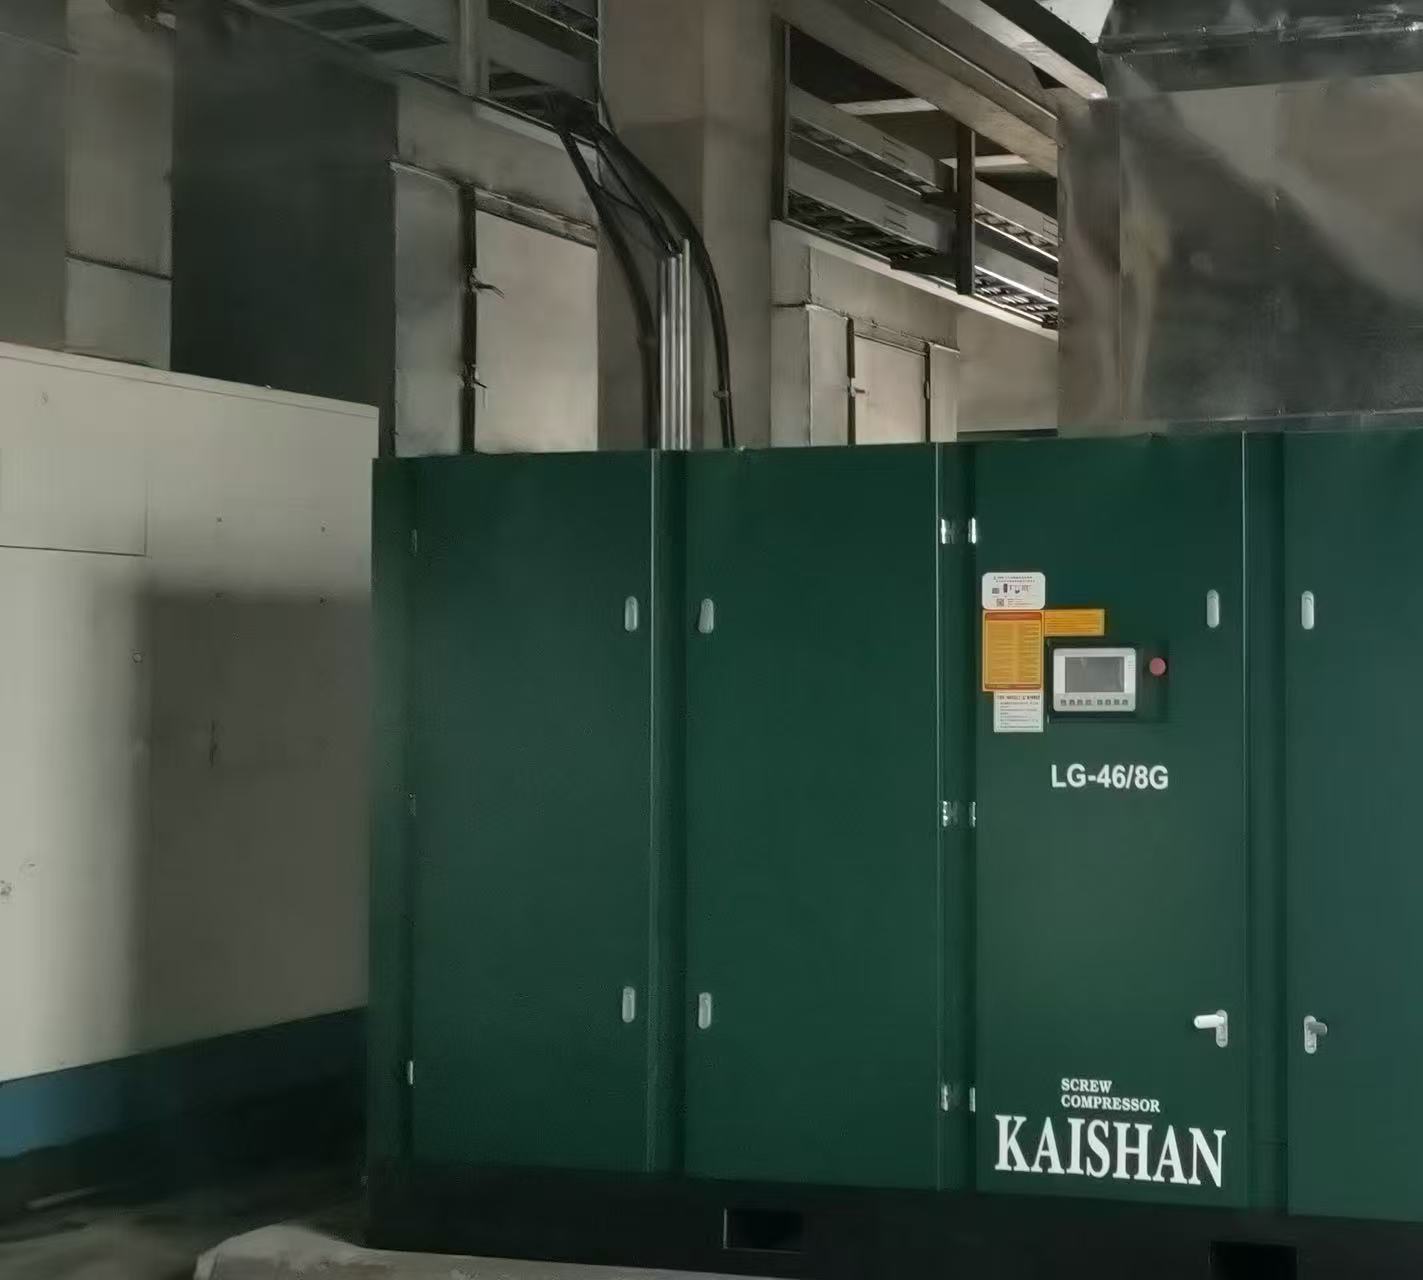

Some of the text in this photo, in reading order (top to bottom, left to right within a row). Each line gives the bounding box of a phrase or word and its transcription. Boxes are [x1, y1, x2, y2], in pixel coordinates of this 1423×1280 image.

[1051, 763, 1169, 790] LG-46/8G
[1061, 1078, 1113, 1093] SCREW
[1061, 1095, 1161, 1113] COMPRESSOR
[994, 1114, 1227, 1188] KAISHAN
